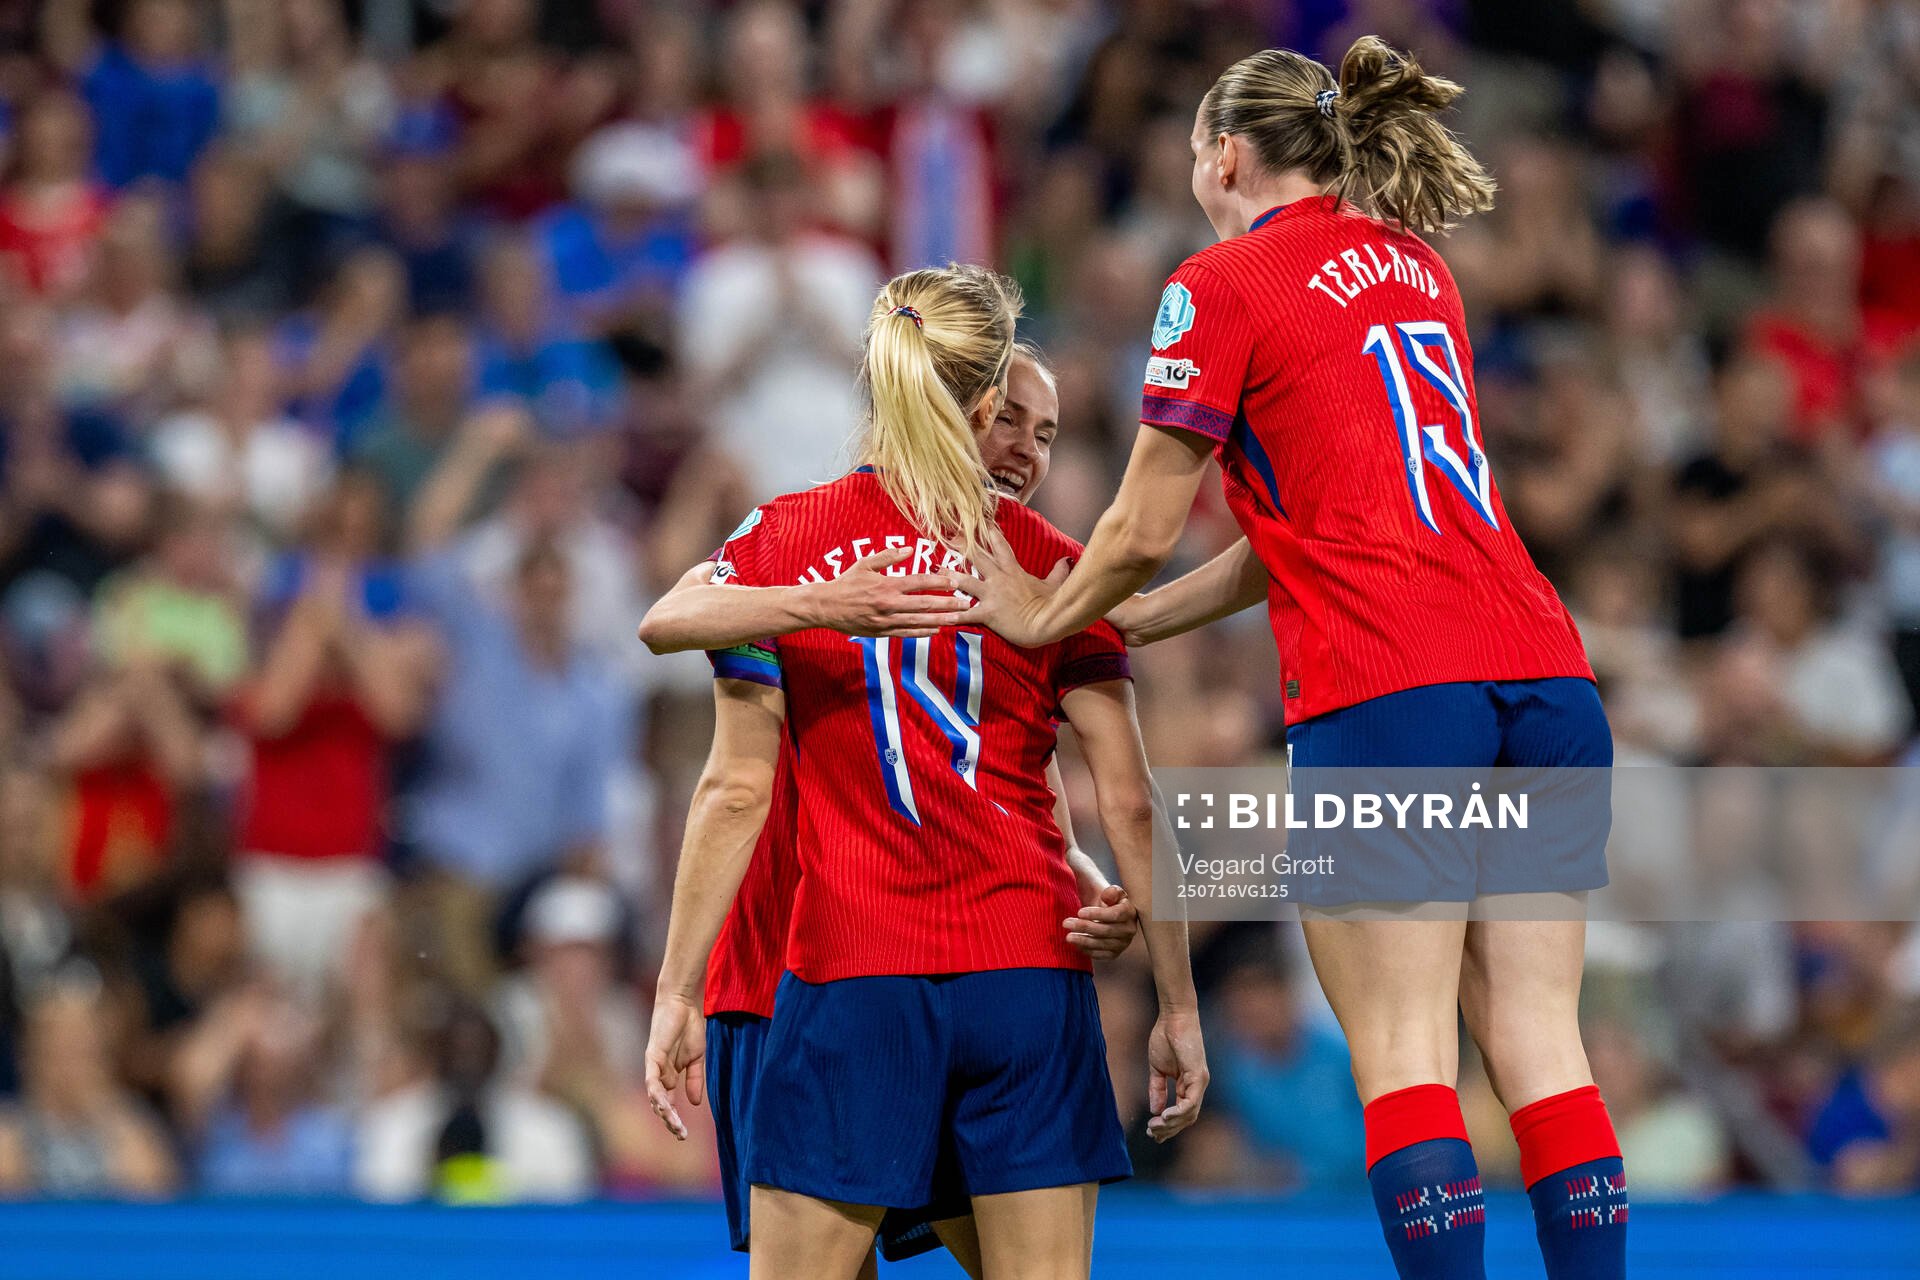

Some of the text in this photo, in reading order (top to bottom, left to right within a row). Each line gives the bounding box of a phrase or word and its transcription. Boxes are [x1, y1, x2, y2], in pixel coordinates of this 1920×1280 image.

[1307, 243, 1440, 308] TERLAND
[1166, 365, 1187, 381] 10
[1361, 321, 1501, 536] 19
[849, 630, 982, 828] 14
